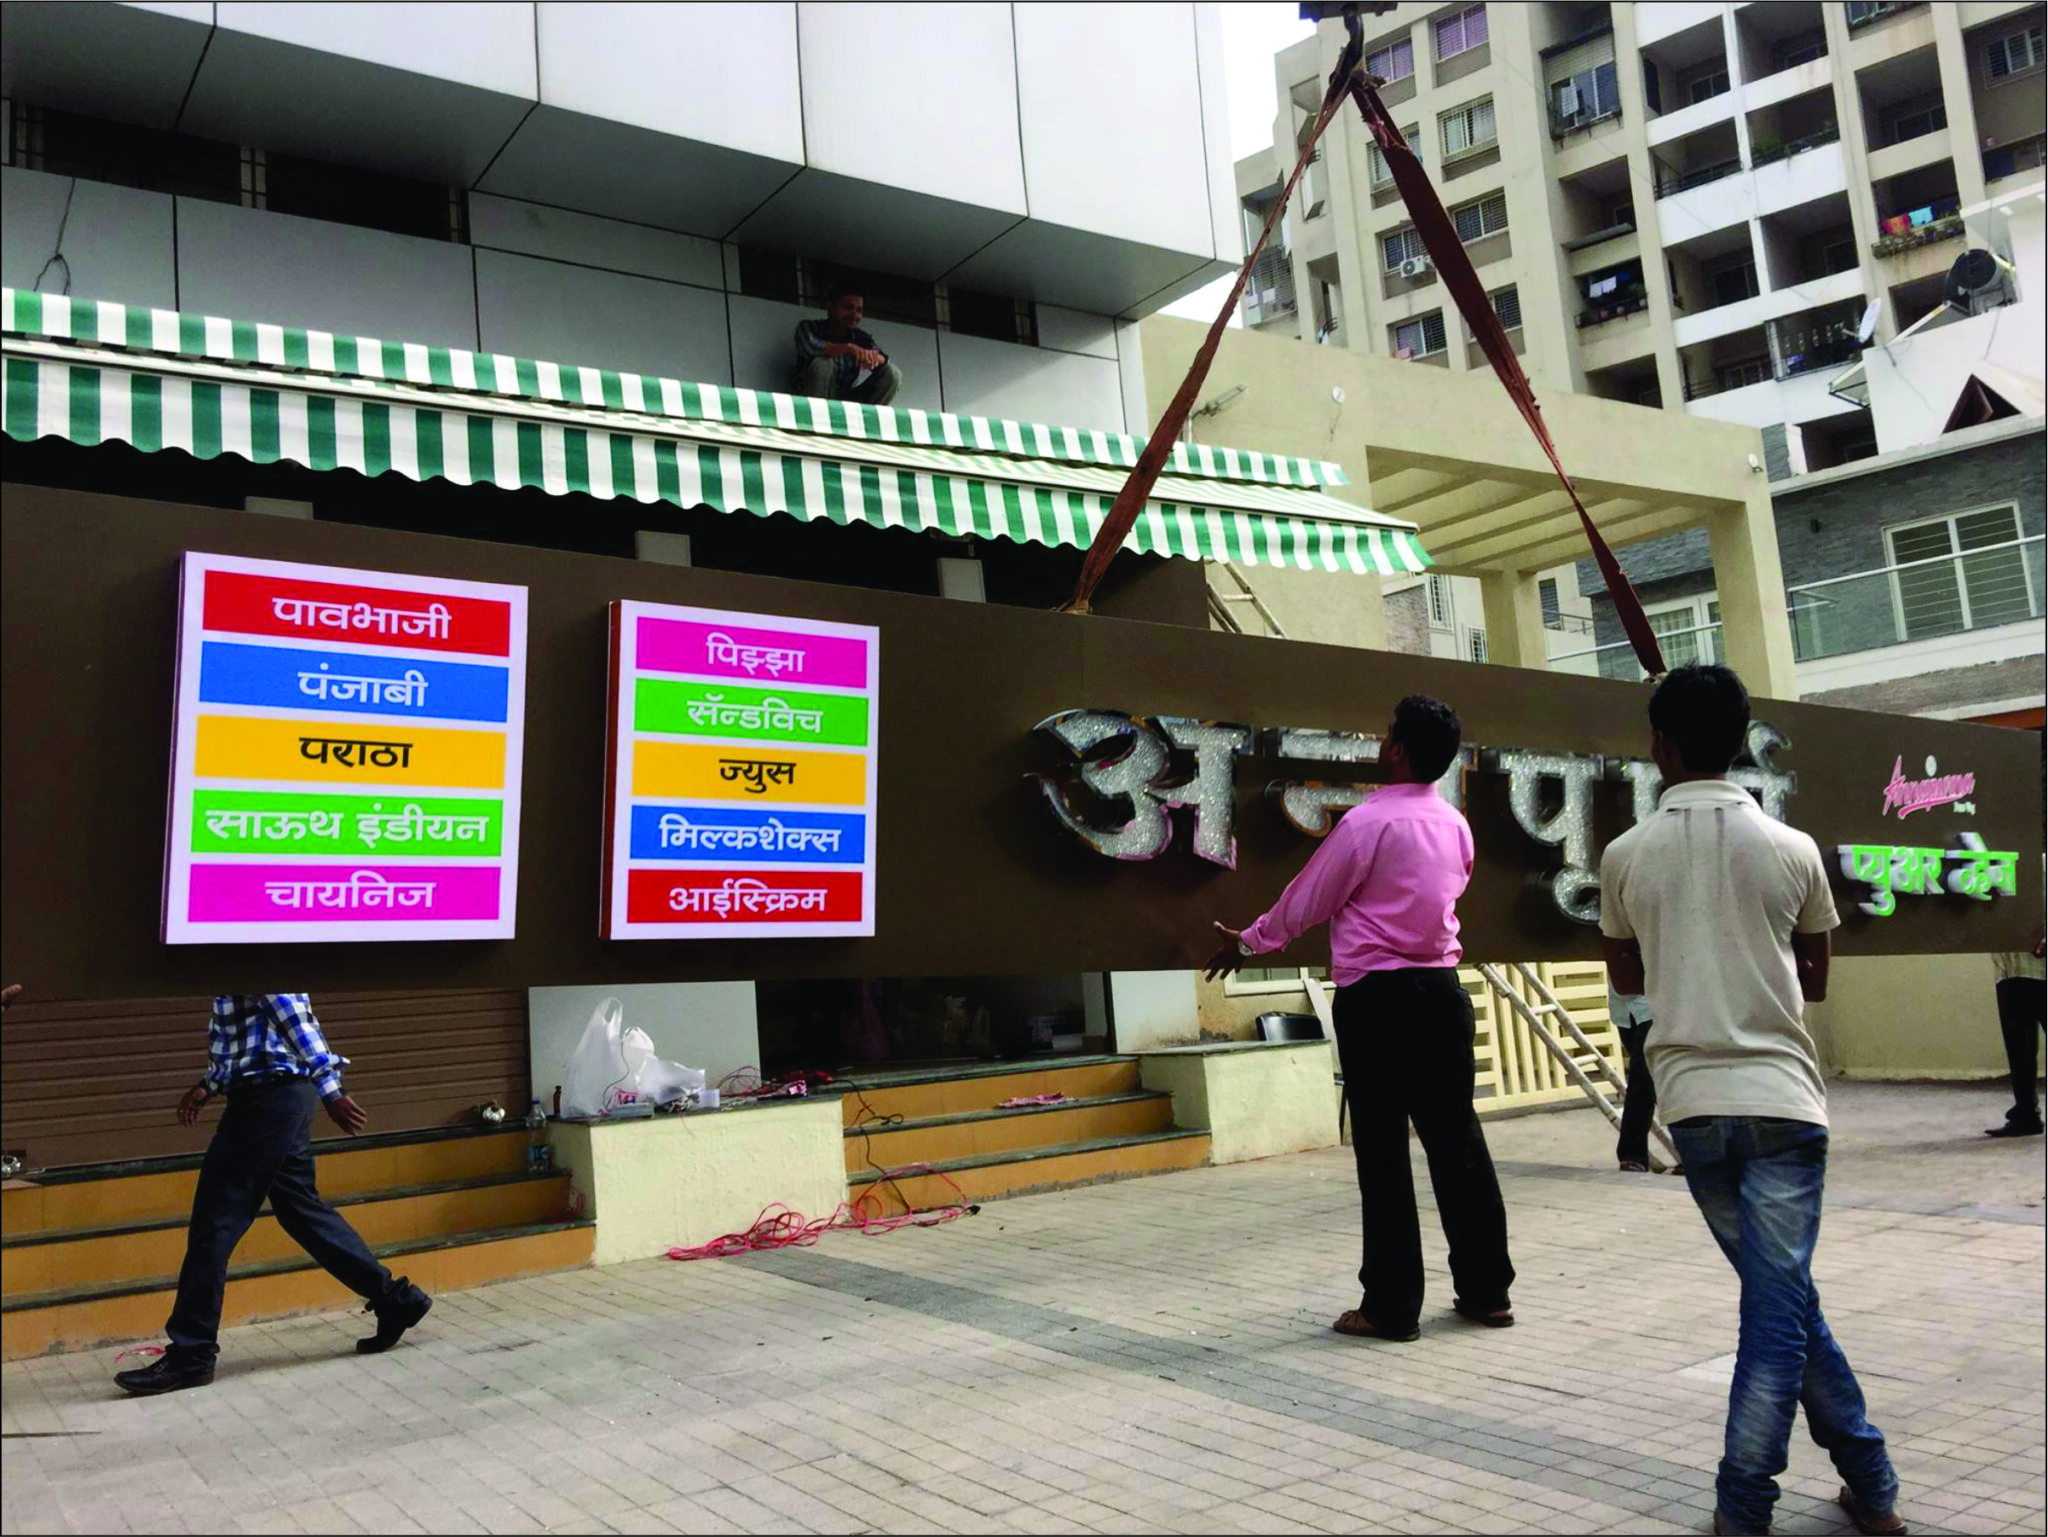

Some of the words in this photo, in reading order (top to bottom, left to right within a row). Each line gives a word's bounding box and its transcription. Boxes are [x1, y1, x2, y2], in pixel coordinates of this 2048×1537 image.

[272, 597, 452, 639] पावभाजी
[706, 632, 806, 677] पिझ्झा
[298, 662, 429, 707] पंजाबी
[687, 693, 823, 733] सॅन्डविच
[299, 737, 413, 768] पराठा
[719, 759, 796, 794] ज्युस
[205, 809, 344, 839] साऊथ
[356, 803, 490, 849] इंडीयन
[659, 813, 842, 853] मिल्कशेक्स
[265, 870, 436, 909] चायनिज
[669, 878, 828, 919] आईस्क्रिम
